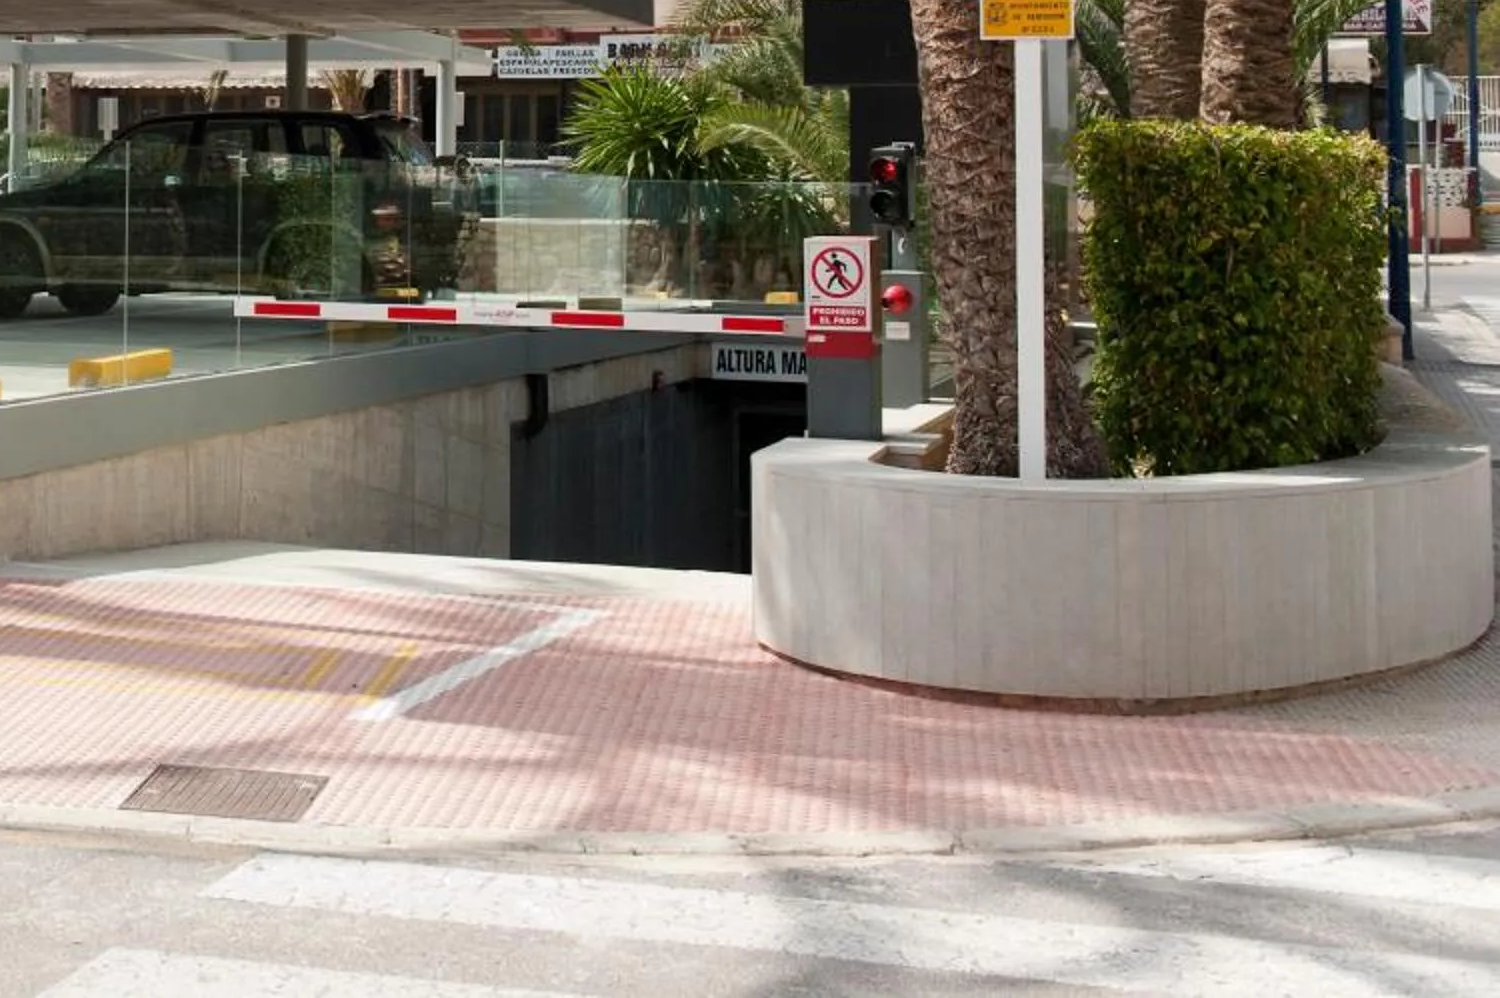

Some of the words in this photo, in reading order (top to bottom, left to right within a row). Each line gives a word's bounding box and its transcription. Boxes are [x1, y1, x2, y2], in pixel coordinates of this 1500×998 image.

[812, 306, 865, 316] PROHIBIDO
[819, 315, 833, 325] EL
[833, 315, 859, 326] PASO
[716, 349, 776, 374] ALTURA
